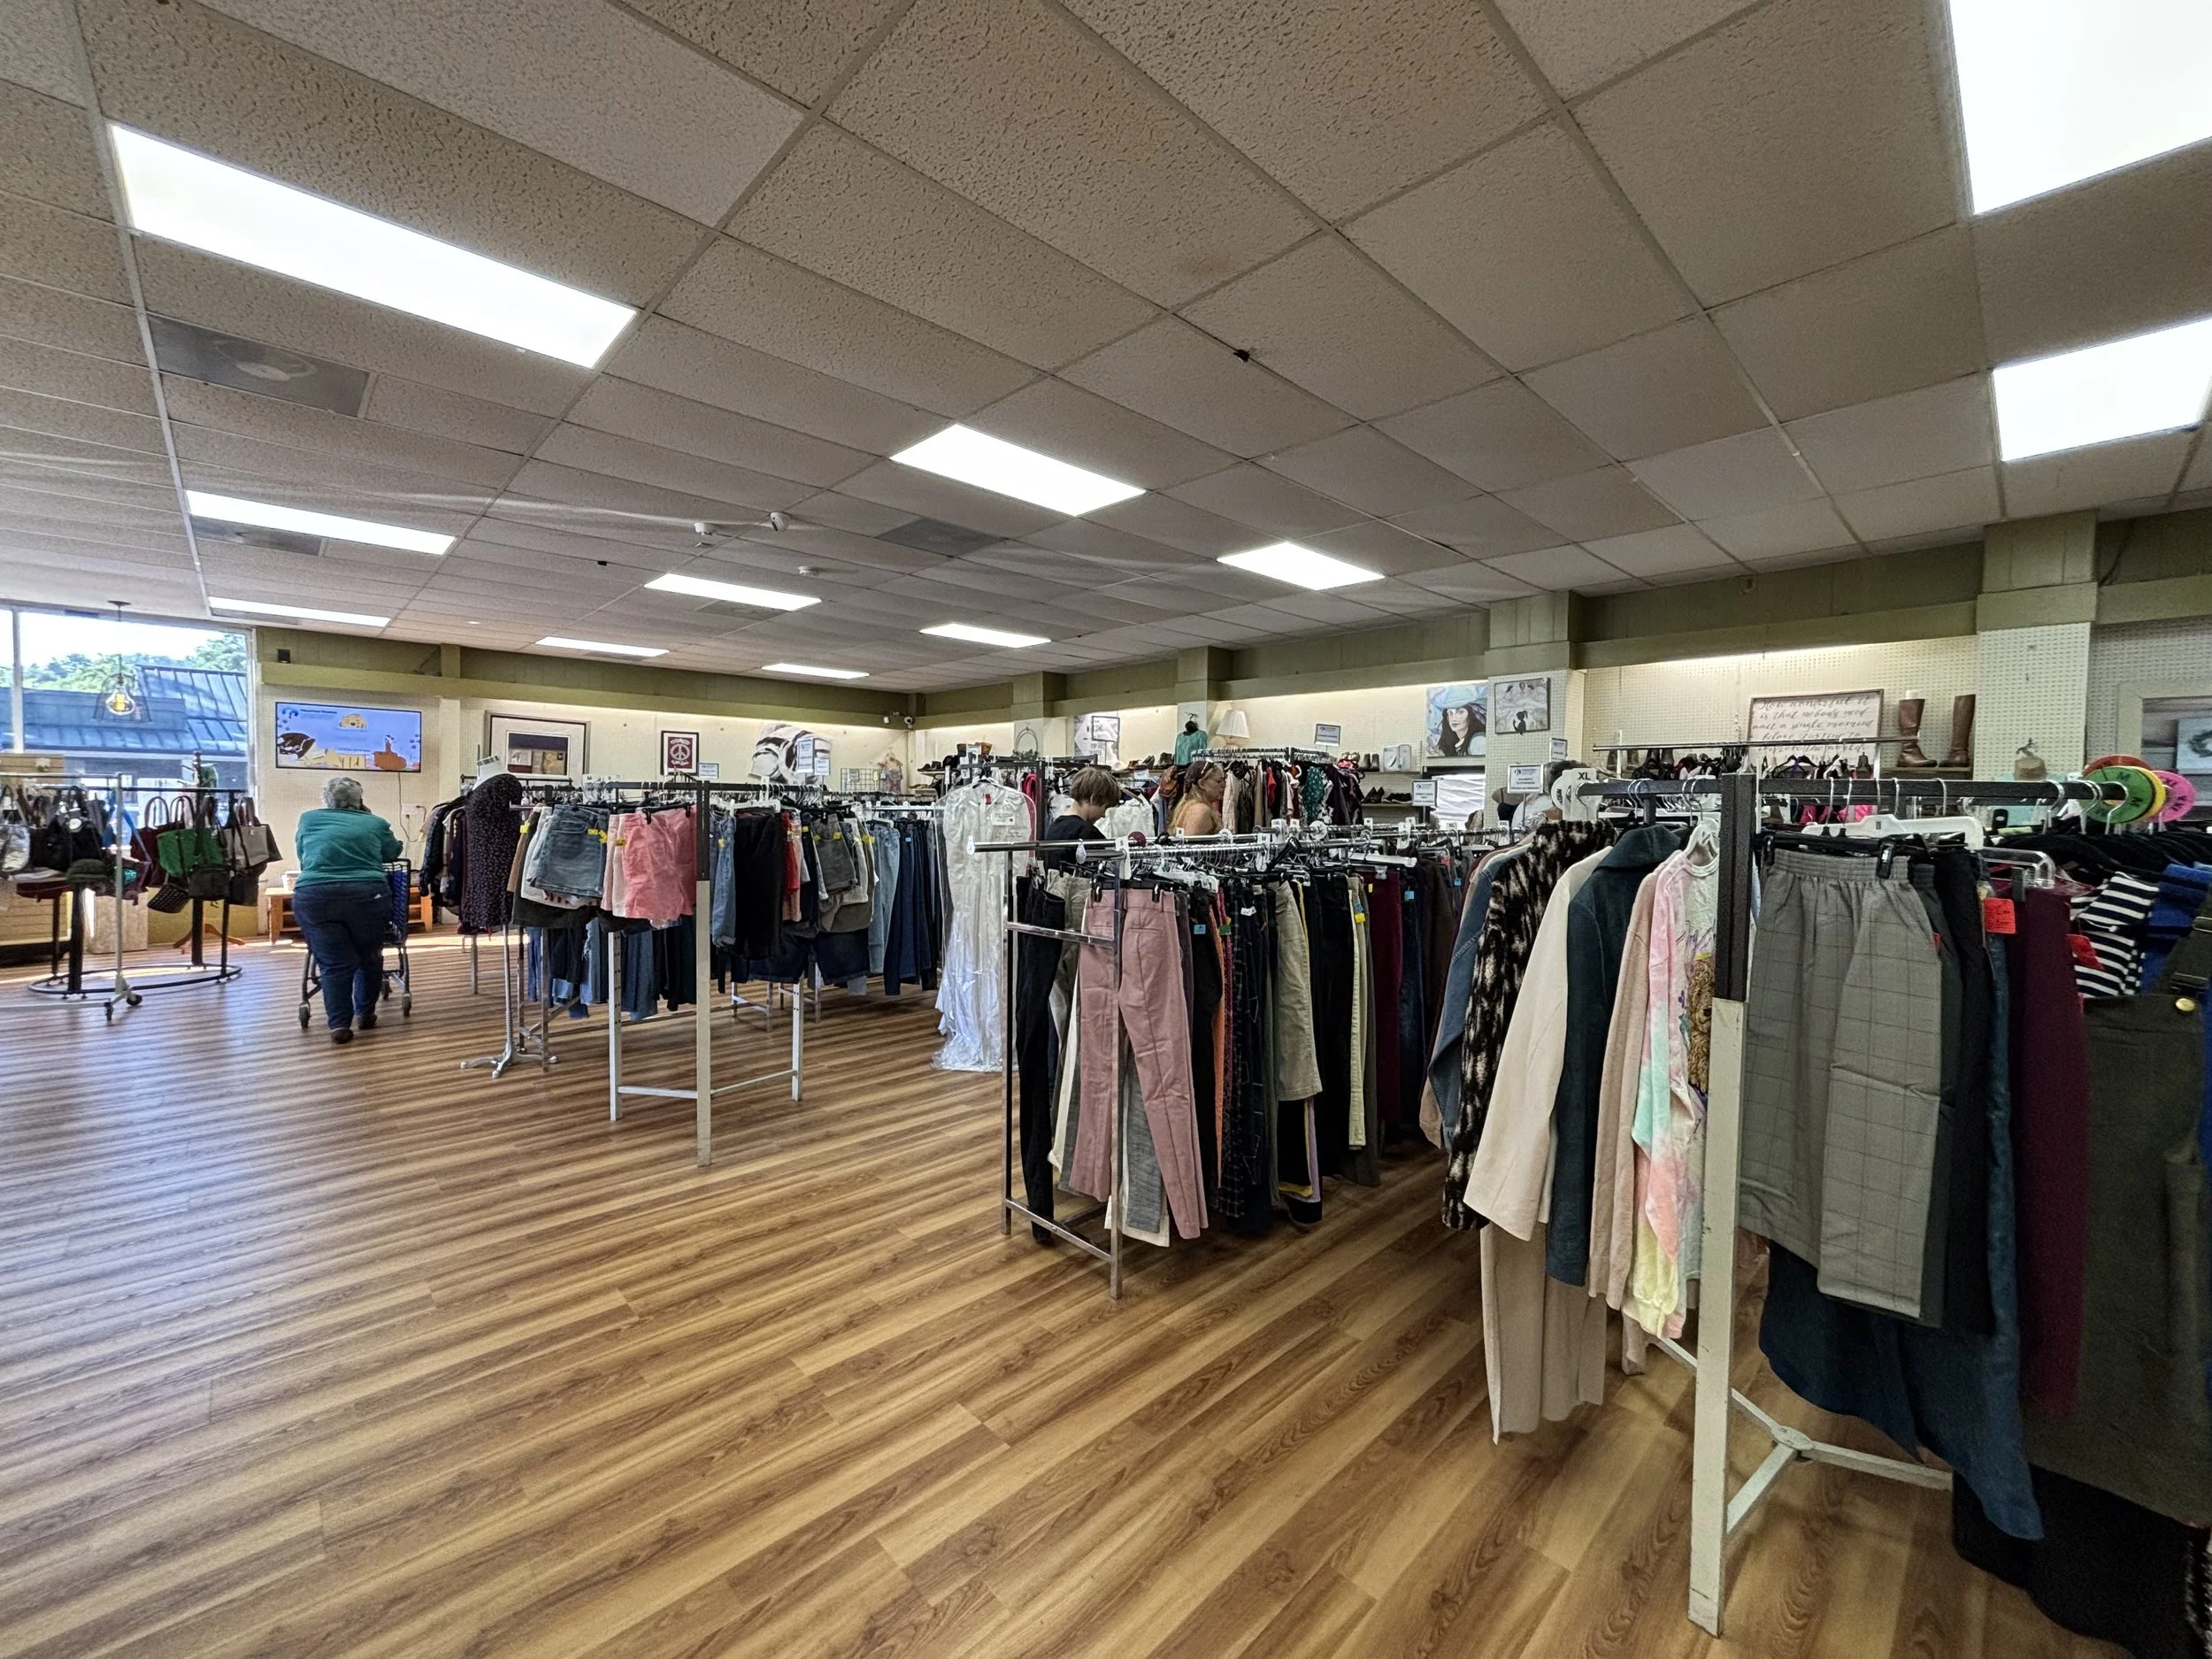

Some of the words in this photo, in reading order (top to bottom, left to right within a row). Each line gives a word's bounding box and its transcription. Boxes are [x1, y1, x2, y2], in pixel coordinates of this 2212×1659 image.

[1789, 696, 1850, 709] wonderful
[1772, 709, 1799, 719] that
[1790, 718, 1823, 732] single
[1825, 719, 1875, 729] moment
[1578, 772, 1592, 780] XL
